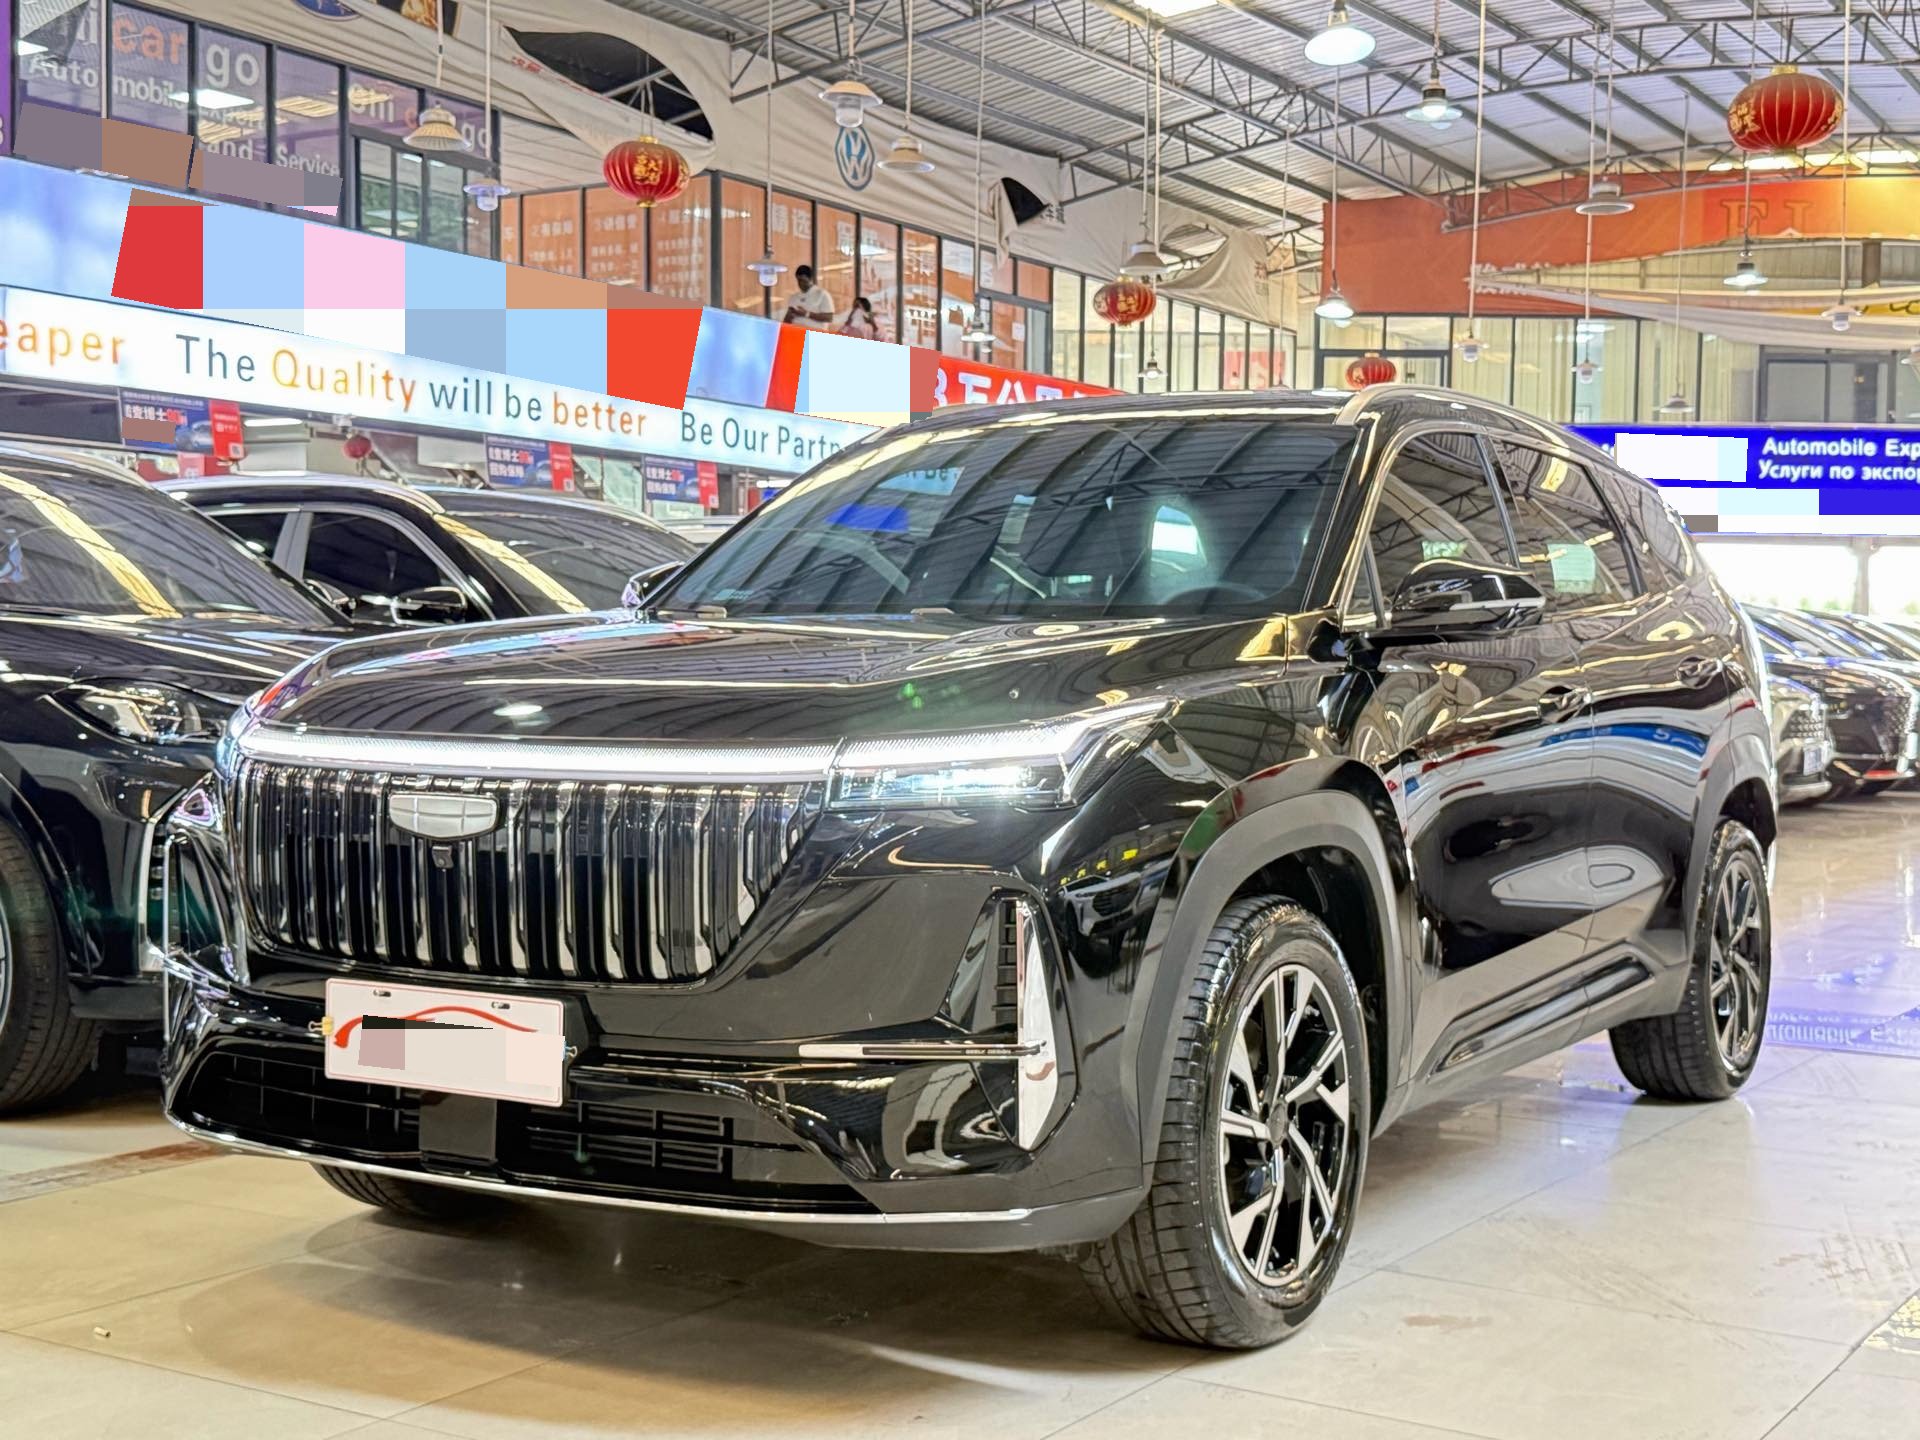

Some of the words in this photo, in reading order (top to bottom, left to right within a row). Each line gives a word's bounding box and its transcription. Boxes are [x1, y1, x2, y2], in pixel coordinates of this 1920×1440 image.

[112, 14, 187, 65] car
[205, 42, 260, 88] go
[175, 333, 255, 382] The
[272, 348, 416, 413] Quality
[429, 376, 492, 416] will
[505, 383, 542, 422] be
[553, 391, 647, 436] better
[681, 411, 713, 445] Be
[722, 417, 769, 453] Our
[1762, 436, 1878, 457] Automobile
[1758, 459, 1824, 483] Услуги
[1829, 465, 1855, 480] по
